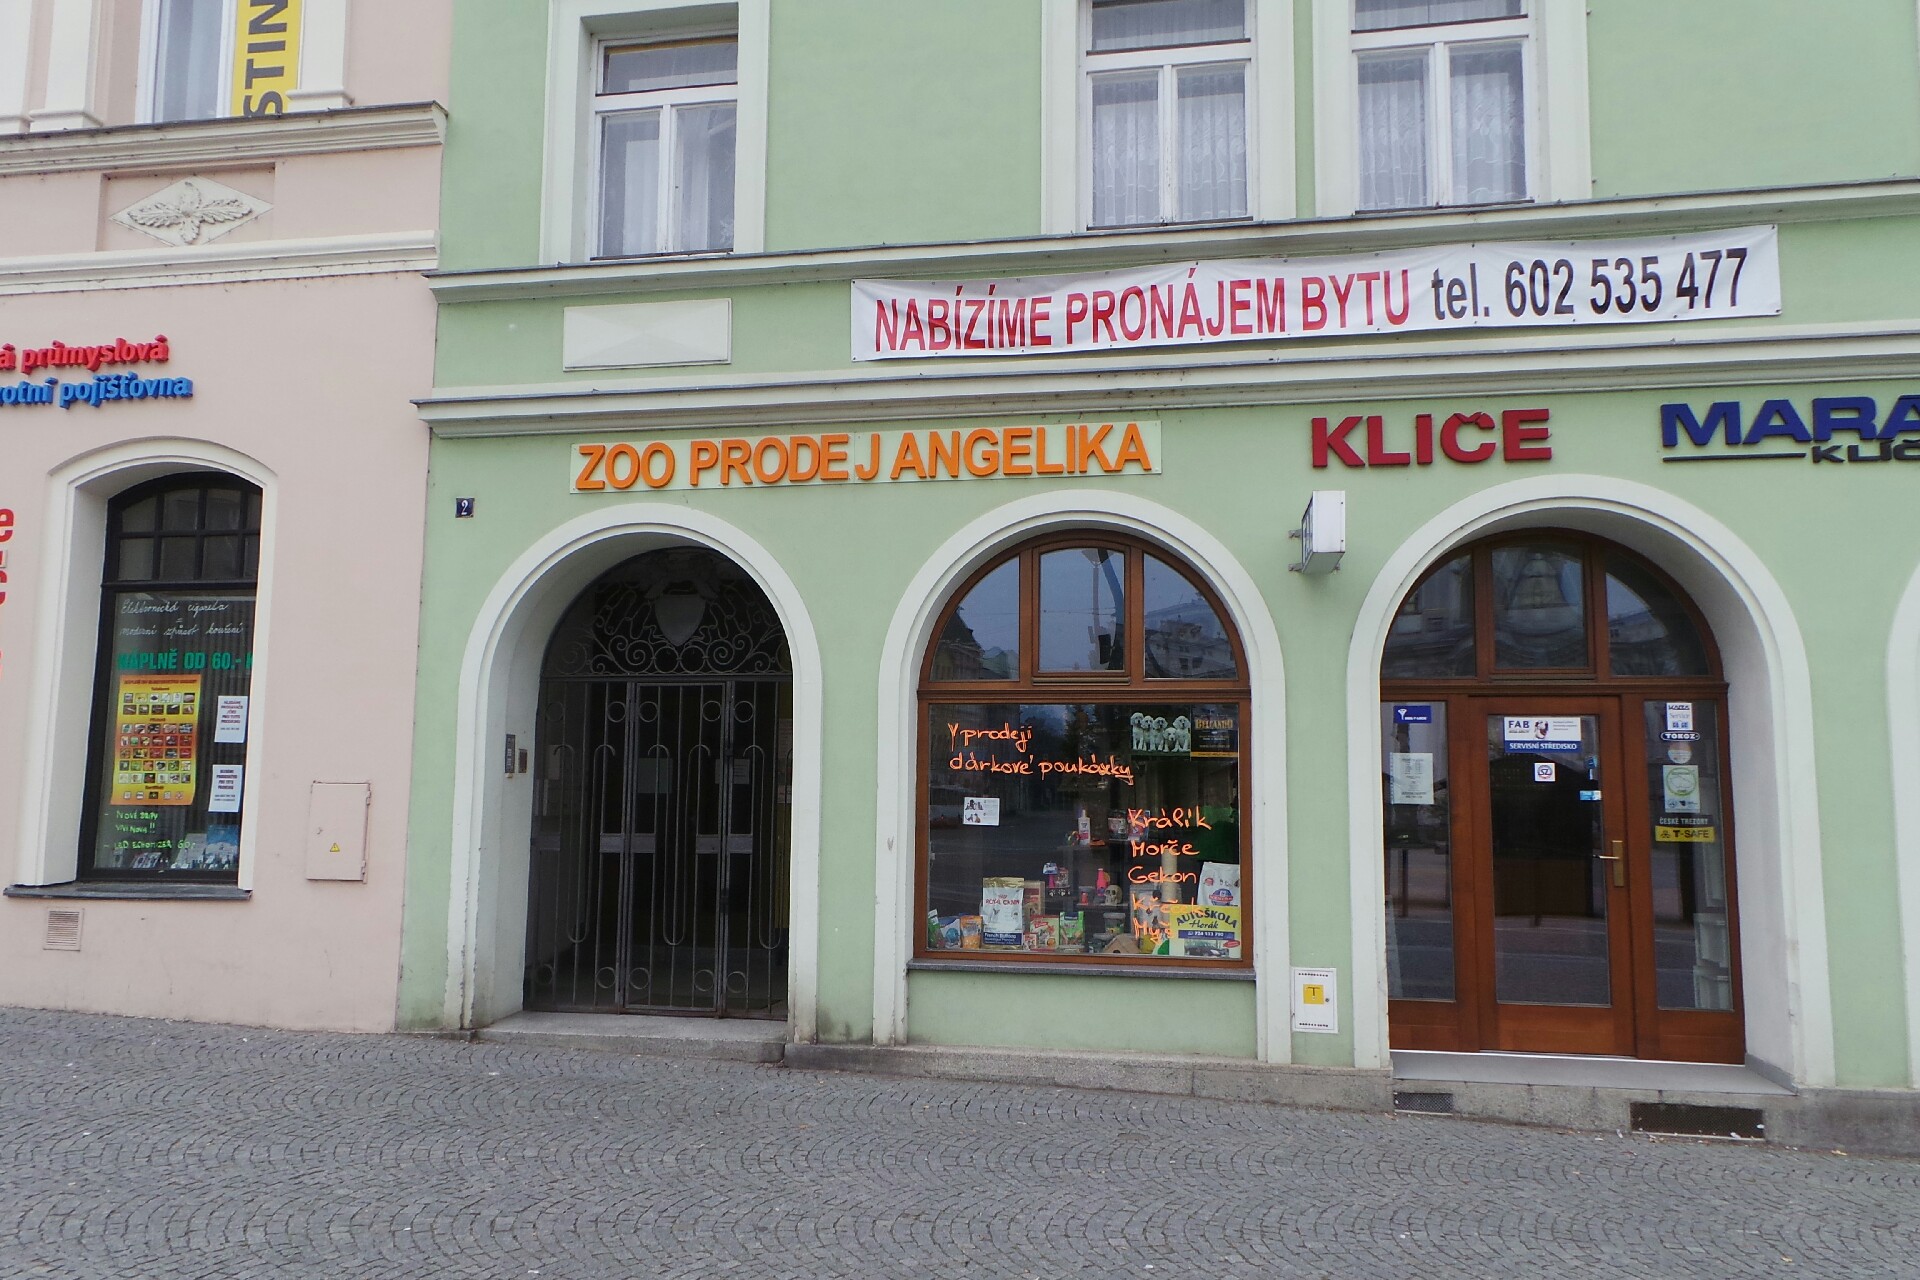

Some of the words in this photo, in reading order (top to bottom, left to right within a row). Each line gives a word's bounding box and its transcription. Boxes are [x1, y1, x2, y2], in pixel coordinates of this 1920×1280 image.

[876, 283, 1053, 352] NABÍZÍME
[1066, 268, 1286, 344] PRONÁJEM
[1302, 268, 1410, 331] BYTU
[1431, 262, 1490, 321] tel.
[1505, 258, 1575, 317] 602
[1589, 256, 1662, 314] 535
[1676, 248, 1748, 310] 477
[21, 334, 169, 375] průmyslová
[0, 377, 58, 405] otní
[60, 371, 193, 409] pojišťovna
[575, 442, 676, 489] ZOO
[690, 432, 881, 485] PRODEJ
[890, 423, 1153, 478] ANGELIKA
[461, 500, 469, 515] 2
[184, 652, 205, 669] OD
[1508, 720, 1530, 729] FAB
[1509, 742, 1540, 750] SERVISNÍ
[1540, 742, 1577, 750] STŘEDISKO
[1673, 830, 1709, 838] T-SAFE
[1131, 839, 1200, 858] Morče
[1128, 866, 1197, 884] Gekon
[1177, 908, 1237, 928] AUTOŠKOLA
[1189, 920, 1219, 929] Horák
